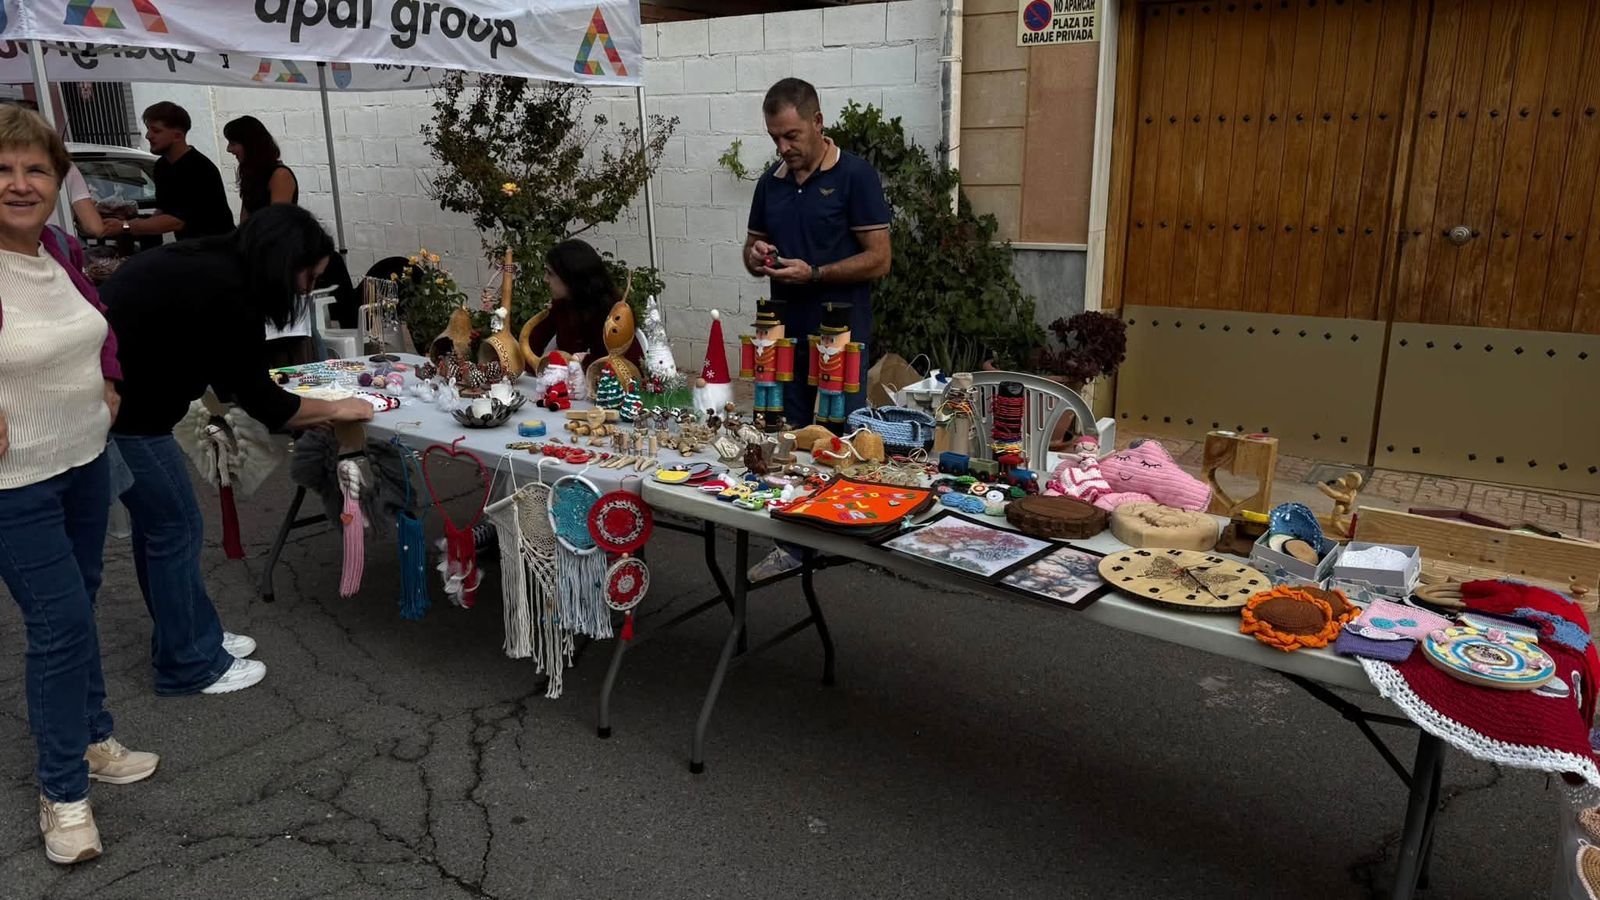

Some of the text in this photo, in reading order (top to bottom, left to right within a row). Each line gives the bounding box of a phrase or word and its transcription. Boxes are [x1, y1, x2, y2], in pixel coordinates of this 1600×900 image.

[1054, 0, 1095, 12] NO APARCAR
[1053, 16, 1094, 29] PLAZA DE
[390, 0, 518, 59] group
[1022, 29, 1093, 43] GARAJE PRIVADA
